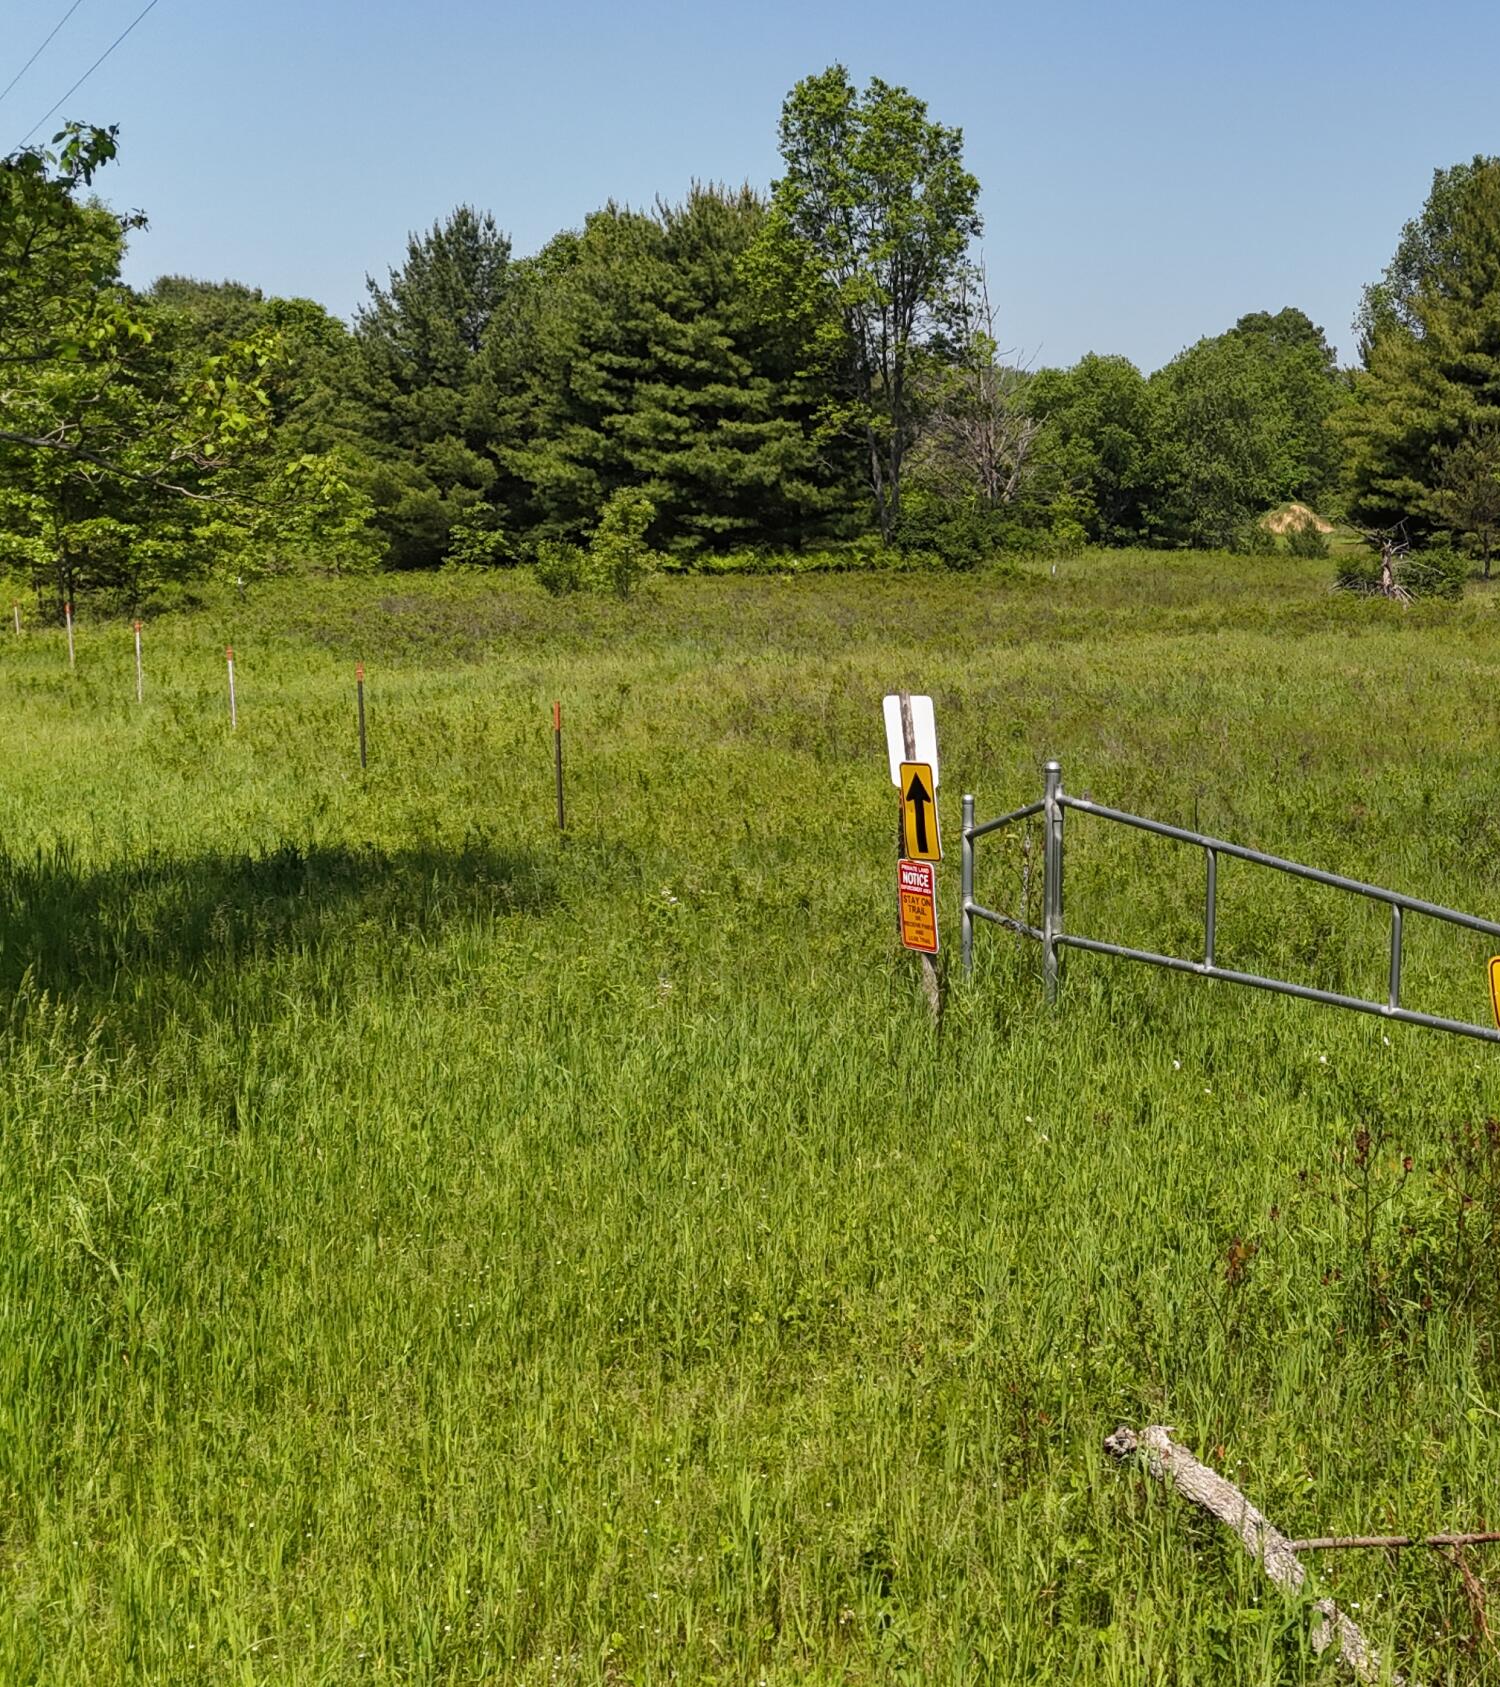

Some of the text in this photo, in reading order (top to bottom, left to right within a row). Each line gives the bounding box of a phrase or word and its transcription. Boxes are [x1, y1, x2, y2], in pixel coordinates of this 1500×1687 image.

[902, 871, 930, 888] NOTICE
[903, 894, 931, 906] STAY ON
[907, 904, 927, 916] TRAIL
